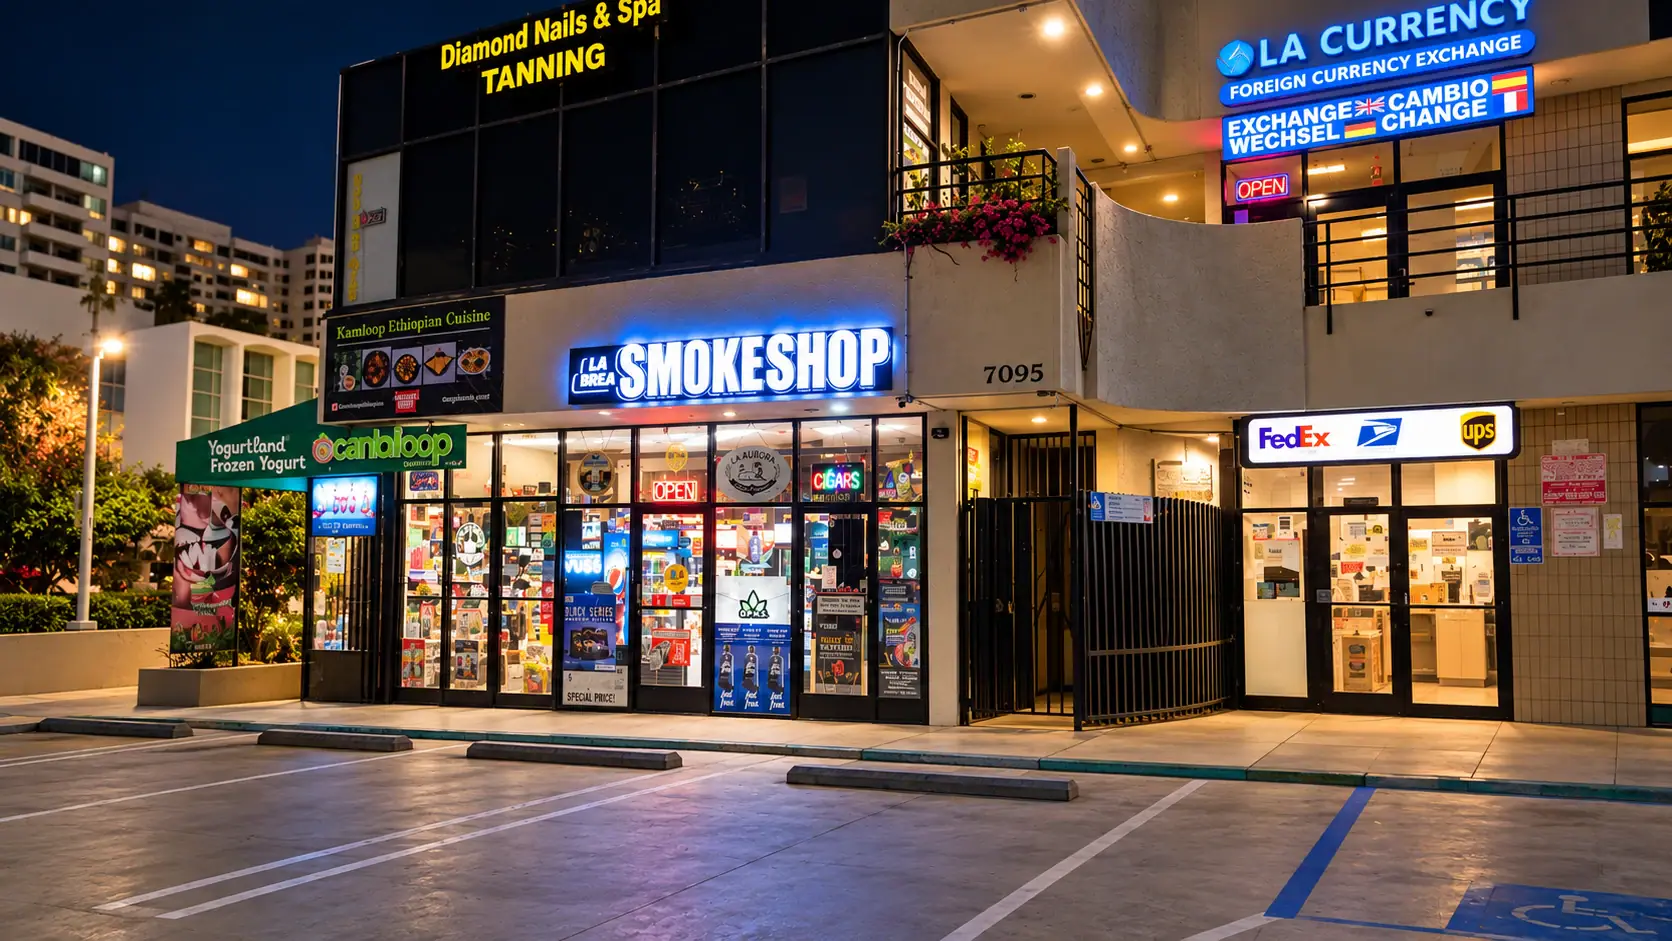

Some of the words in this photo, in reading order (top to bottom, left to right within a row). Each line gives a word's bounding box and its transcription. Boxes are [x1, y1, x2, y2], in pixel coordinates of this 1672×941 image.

[441, 23, 528, 70] Diamond
[534, 10, 587, 45] Nails
[593, 2, 611, 29] &
[618, 0, 660, 26] Spa
[1259, 32, 1306, 67] LA
[1320, 0, 1532, 55] CURRENCY
[481, 43, 605, 94] TANNING
[1230, 73, 1306, 100] FOREIGN
[1311, 54, 1411, 86] CURRENCY
[1416, 34, 1521, 67] EXCHANGE
[1228, 101, 1353, 138] EXCHANGE
[1388, 78, 1489, 111] CAMBIO
[1229, 122, 1340, 155] WECHSEL
[1381, 98, 1487, 132] CHANGE
[1238, 176, 1287, 199] OPEN
[336, 323, 386, 340] Kamloop
[389, 315, 442, 334] Ethiopian
[446, 309, 491, 326] Cuisine
[588, 355, 608, 371] LA
[619, 327, 890, 398] SMOKESHOP
[984, 363, 1044, 384] 7095
[580, 372, 615, 387] BREA
[208, 436, 286, 459] Yogurtland
[1259, 425, 1330, 449] FedEx
[1463, 422, 1494, 446] ups
[211, 458, 254, 473] Frozen
[260, 455, 306, 474] Yogurt
[655, 482, 694, 500] OPEN
[813, 469, 860, 489] CIGARS
[567, 692, 592, 702] SPECIAL
